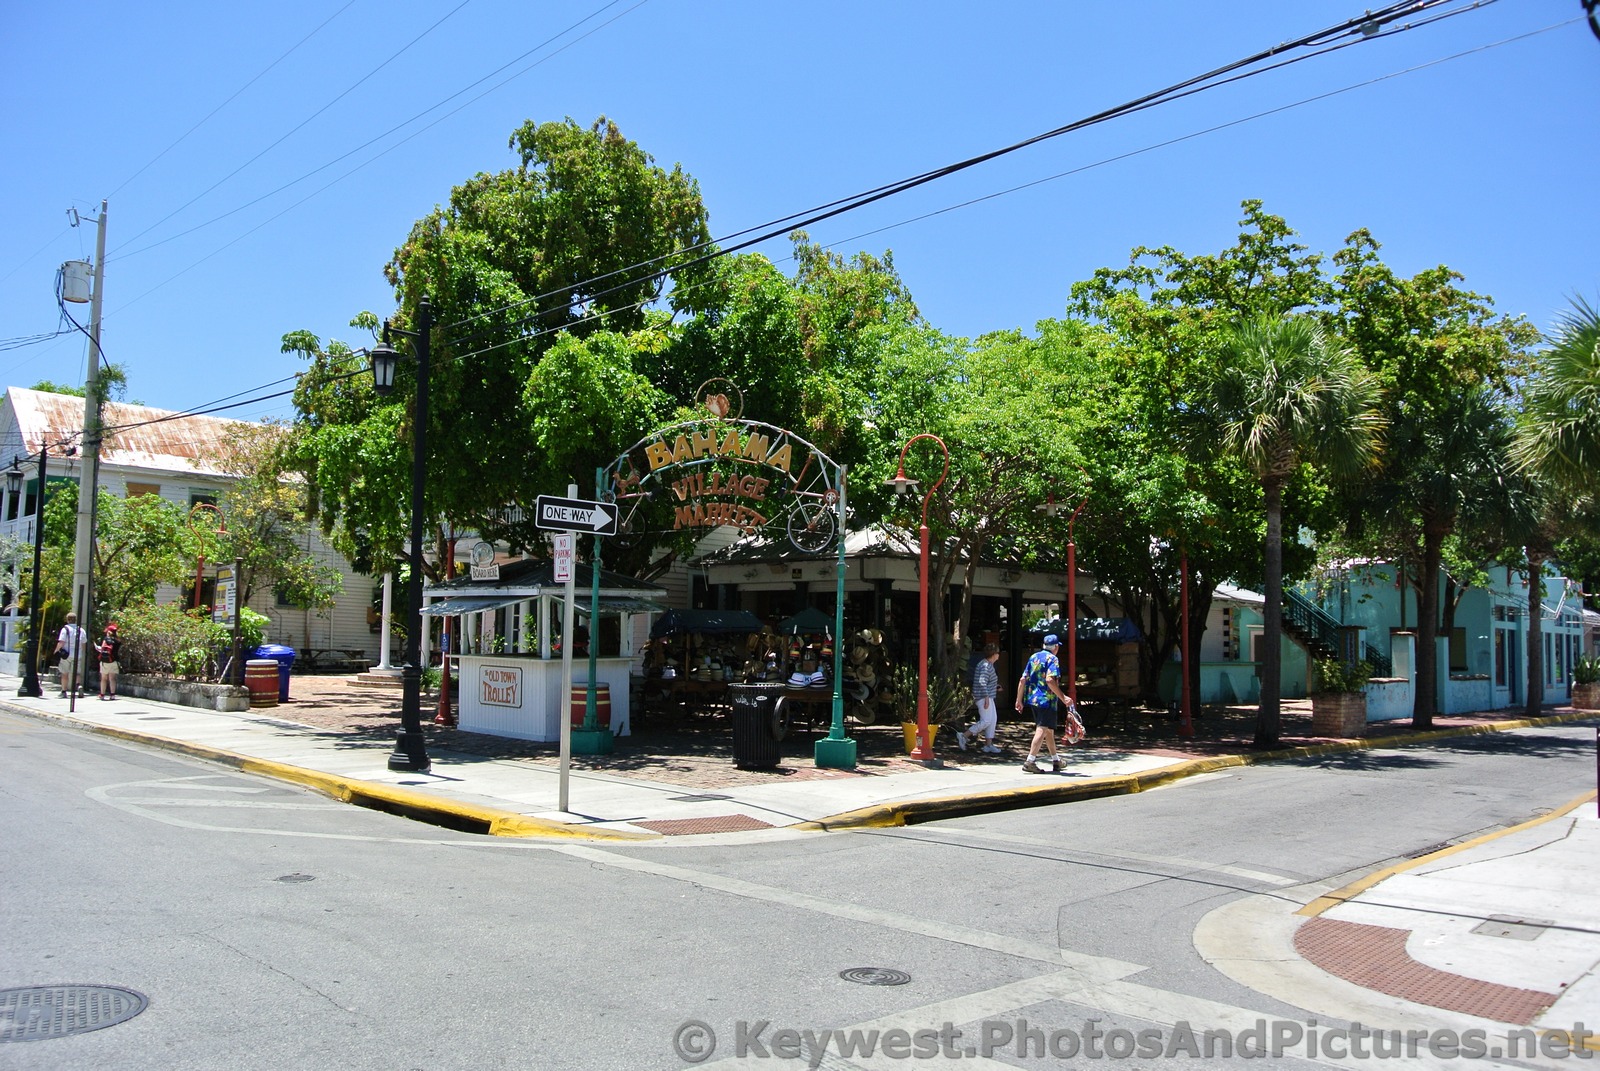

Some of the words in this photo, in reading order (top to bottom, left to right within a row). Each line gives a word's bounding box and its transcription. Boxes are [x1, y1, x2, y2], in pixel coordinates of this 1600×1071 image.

[645, 429, 792, 471] BAHAMA
[672, 472, 770, 501] VILLAGE
[546, 507, 567, 520] ONE
[571, 509, 593, 523] WAY
[674, 503, 768, 534] MARKET
[560, 539, 567, 548] NO
[555, 549, 571, 559] PARKING
[472, 567, 487, 579] BOARD
[487, 566, 498, 578] HERE
[489, 670, 500, 682] OLD
[500, 671, 517, 684] TOWN
[483, 680, 518, 704] TROLLEY
